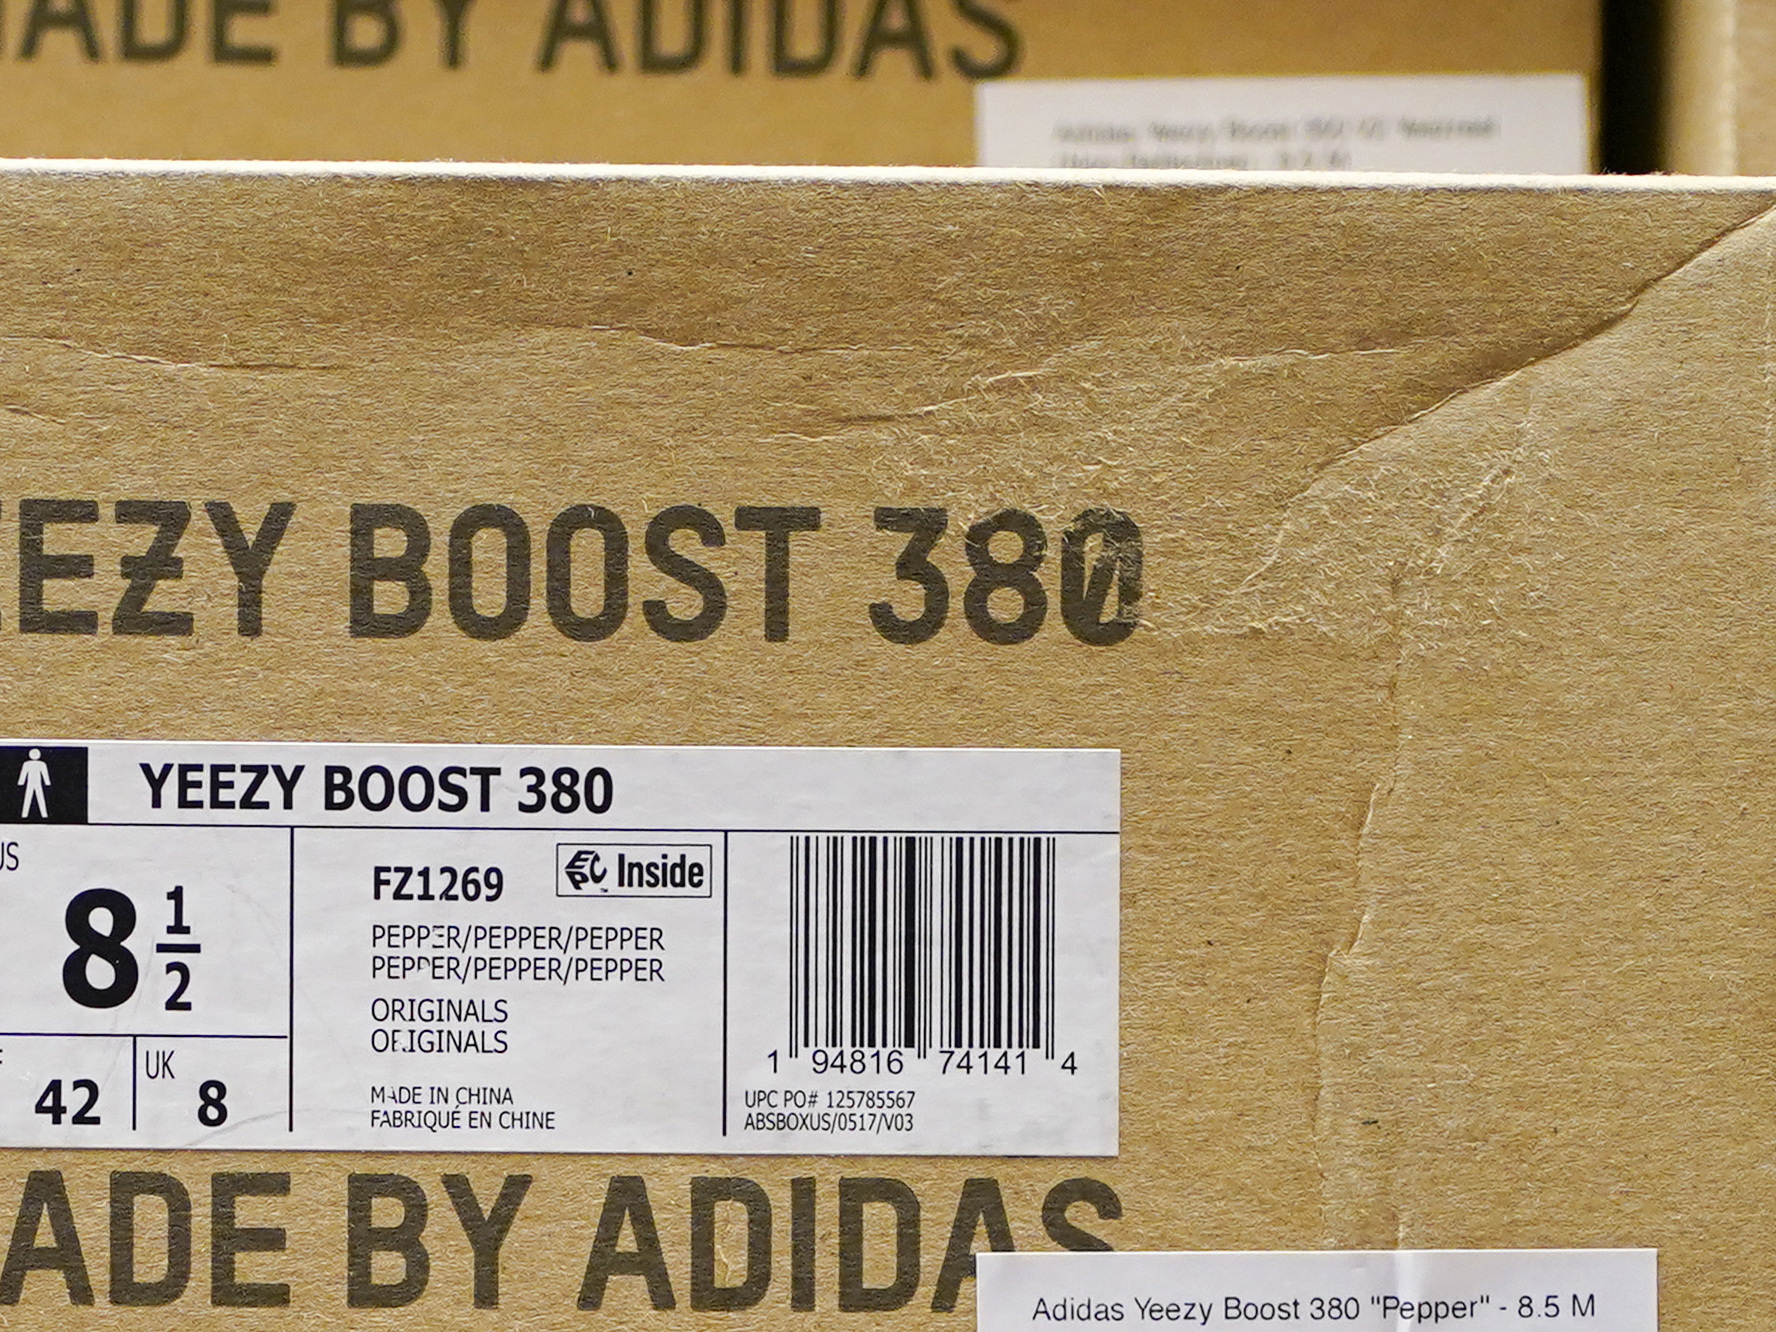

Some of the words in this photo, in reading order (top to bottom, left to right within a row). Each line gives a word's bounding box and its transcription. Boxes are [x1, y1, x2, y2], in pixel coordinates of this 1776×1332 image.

[349, 504, 821, 643] BOOST
[869, 507, 1143, 647] 380
[140, 762, 305, 810] YEEZY
[325, 765, 501, 812] BOOST
[518, 767, 613, 814] 380
[374, 866, 503, 902] FZ1269
[618, 854, 703, 888] Inside
[373, 924, 664, 954] PEPPER/PEPPER/PEPPER
[372, 955, 664, 985] PEPPER/PEPPER/PEPPER
[371, 998, 508, 1023] ORIGINALS
[146, 1051, 175, 1079] UK
[768, 1050, 777, 1073] 1
[812, 1049, 903, 1075] 94816
[939, 1050, 1025, 1075] 74141
[1061, 1052, 1077, 1075] 4
[35, 1078, 100, 1125] 42
[198, 1080, 227, 1127] 8
[430, 1087, 448, 1104] IN
[456, 1087, 513, 1107] CHINA
[745, 1089, 778, 1108] UPC
[784, 1089, 818, 1108] PO#
[828, 1089, 915, 1109] 125785567
[371, 1103, 463, 1133] FABRIQUÉ
[469, 1111, 491, 1129] EN
[499, 1111, 555, 1129] CHINE
[744, 1111, 913, 1134] ABSBOXUS/0517/V03
[347, 1173, 533, 1309] BY
[577, 1175, 1123, 1313] ADIDAS
[1032, 1298, 1124, 1321] Adidas
[1135, 1298, 1212, 1326] Yeezy
[1225, 1297, 1299, 1320] Boost
[1310, 1297, 1360, 1320] 380
[1371, 1295, 1489, 1324] "Pepper"
[1518, 1295, 1560, 1318] 8.5
[1572, 1293, 1594, 1316] M
